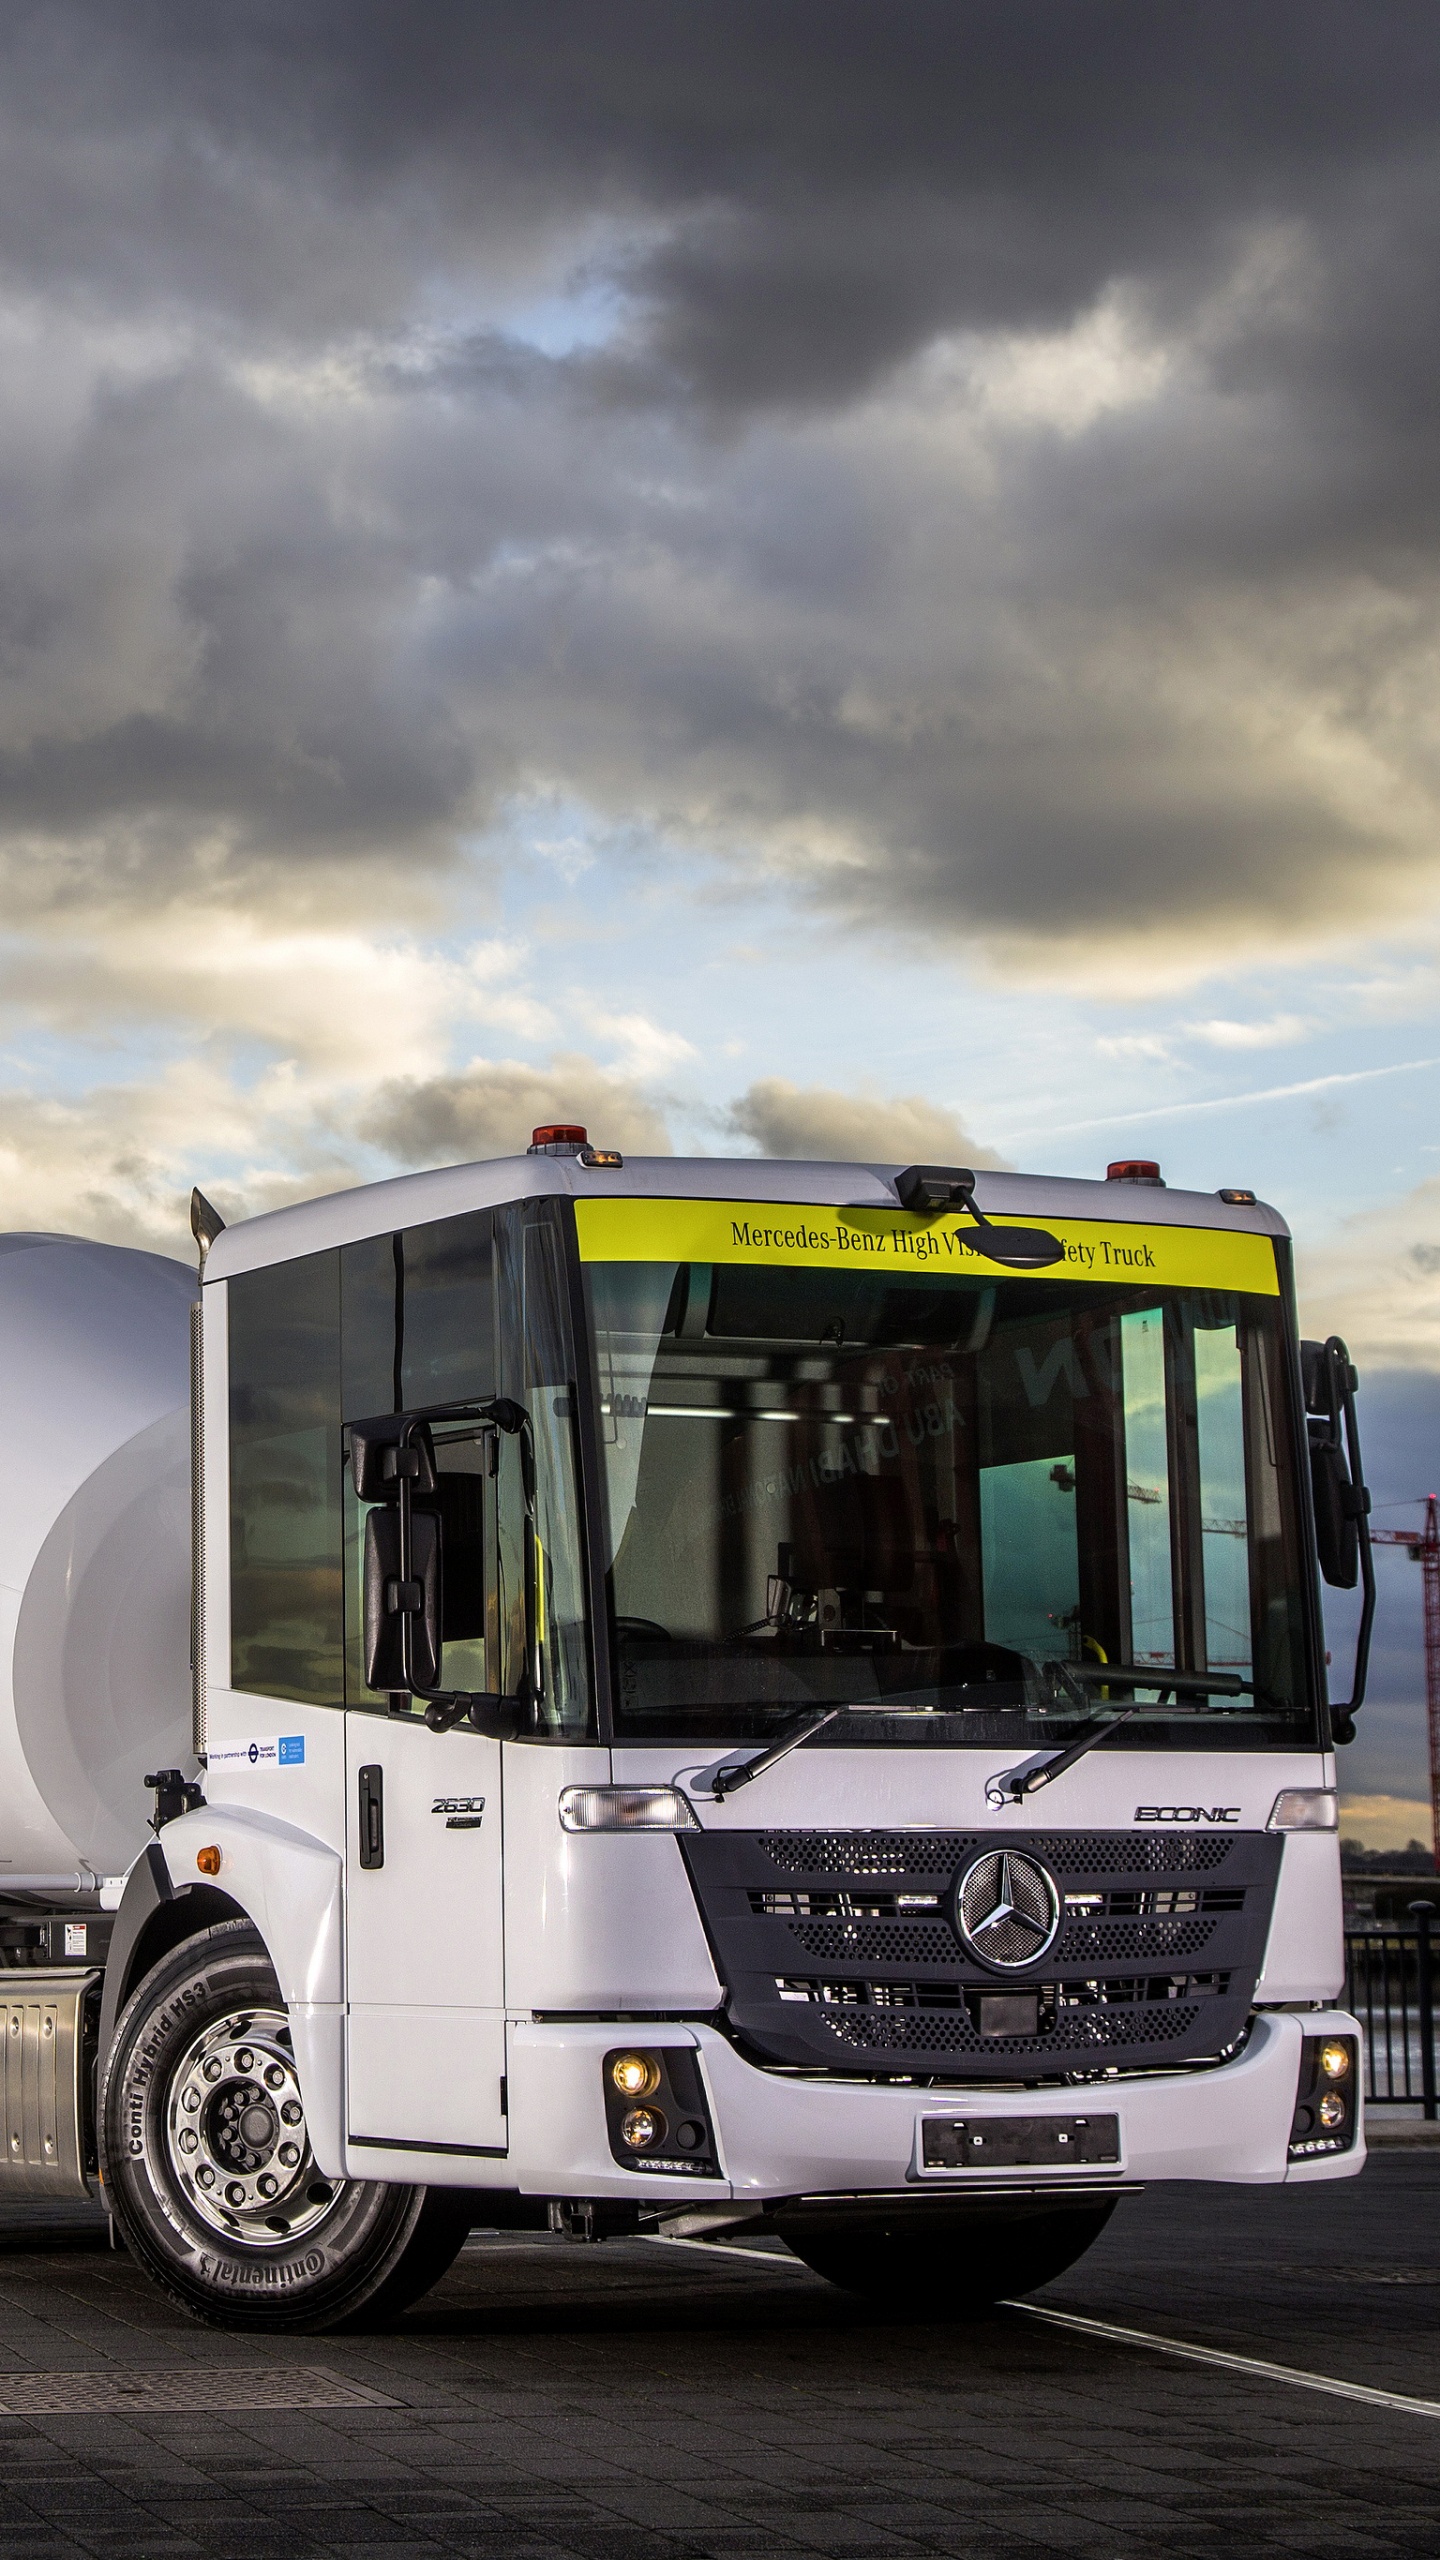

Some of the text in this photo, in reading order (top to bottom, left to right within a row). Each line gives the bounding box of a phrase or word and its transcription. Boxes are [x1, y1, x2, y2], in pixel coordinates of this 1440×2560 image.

[731, 1221, 886, 1252] Mercedes-Benz
[891, 1229, 940, 1260] High
[1100, 1241, 1156, 1267] Truck
[431, 1797, 486, 1813] 2630
[1134, 1806, 1241, 1822] ECONIC
[129, 1981, 207, 2156] Conti Hybrid HS3
[212, 2248, 325, 2289] Continental
